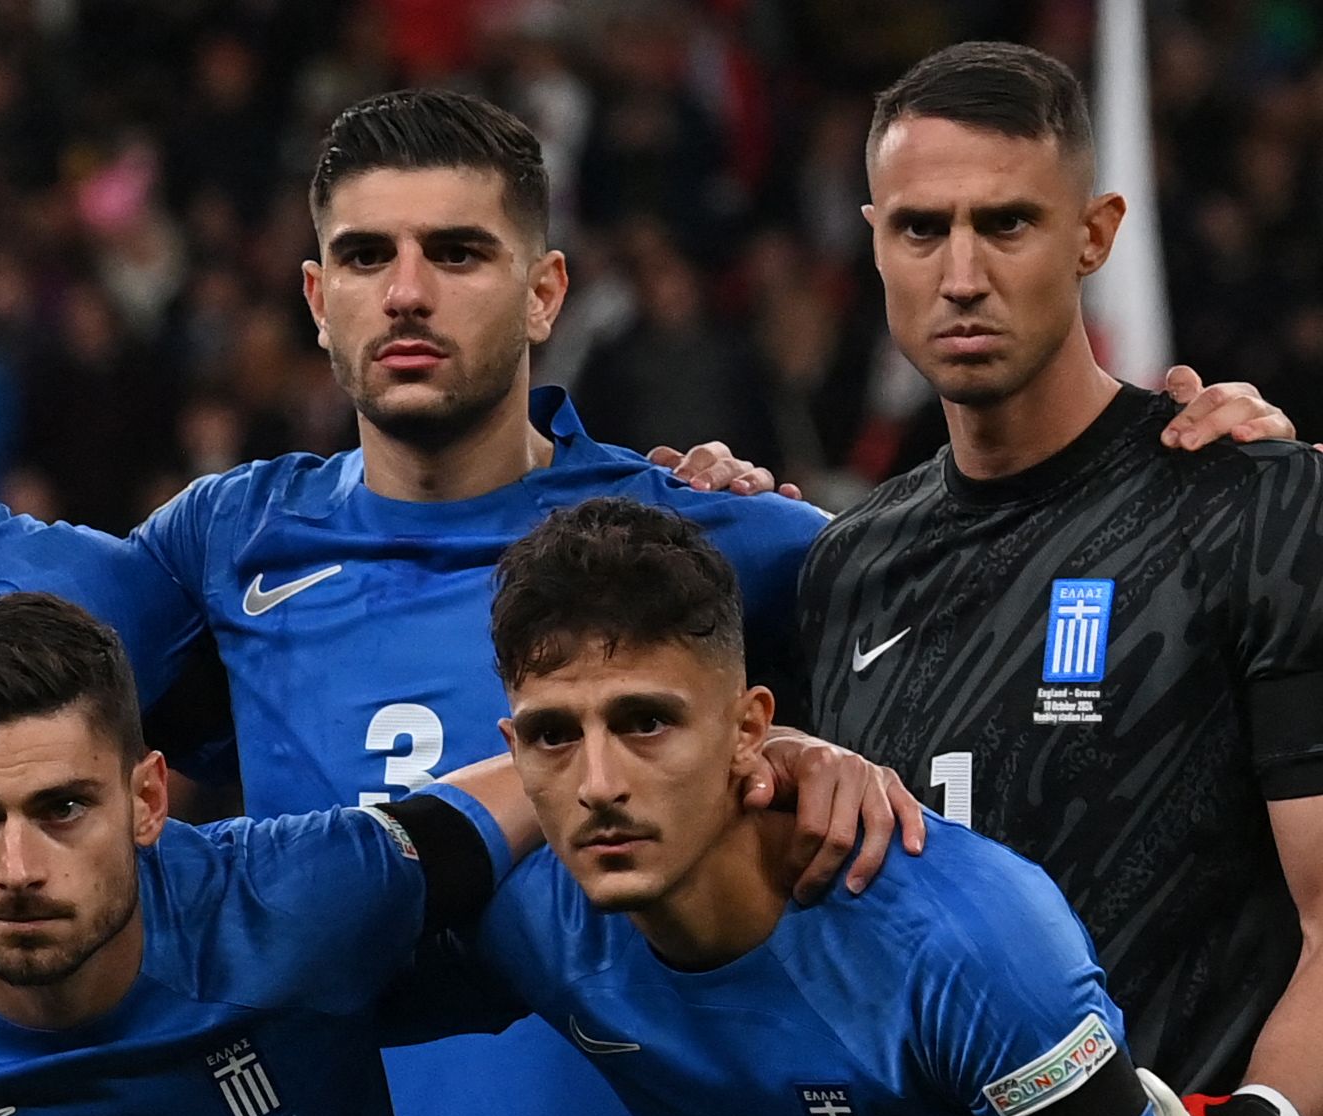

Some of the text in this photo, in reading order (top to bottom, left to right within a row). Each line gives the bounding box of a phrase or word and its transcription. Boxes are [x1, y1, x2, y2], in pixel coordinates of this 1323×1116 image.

[1060, 587, 1103, 599] ΕΛΛΑΣ
[1038, 688, 1067, 700] England
[1075, 688, 1101, 698] Greece
[359, 703, 444, 807] 3
[930, 752, 973, 830] 1
[995, 1028, 1107, 1110] FOUNDATION
[803, 1090, 847, 1101] ΕΛΛΑΣ
[989, 1078, 1019, 1098] UEFA
